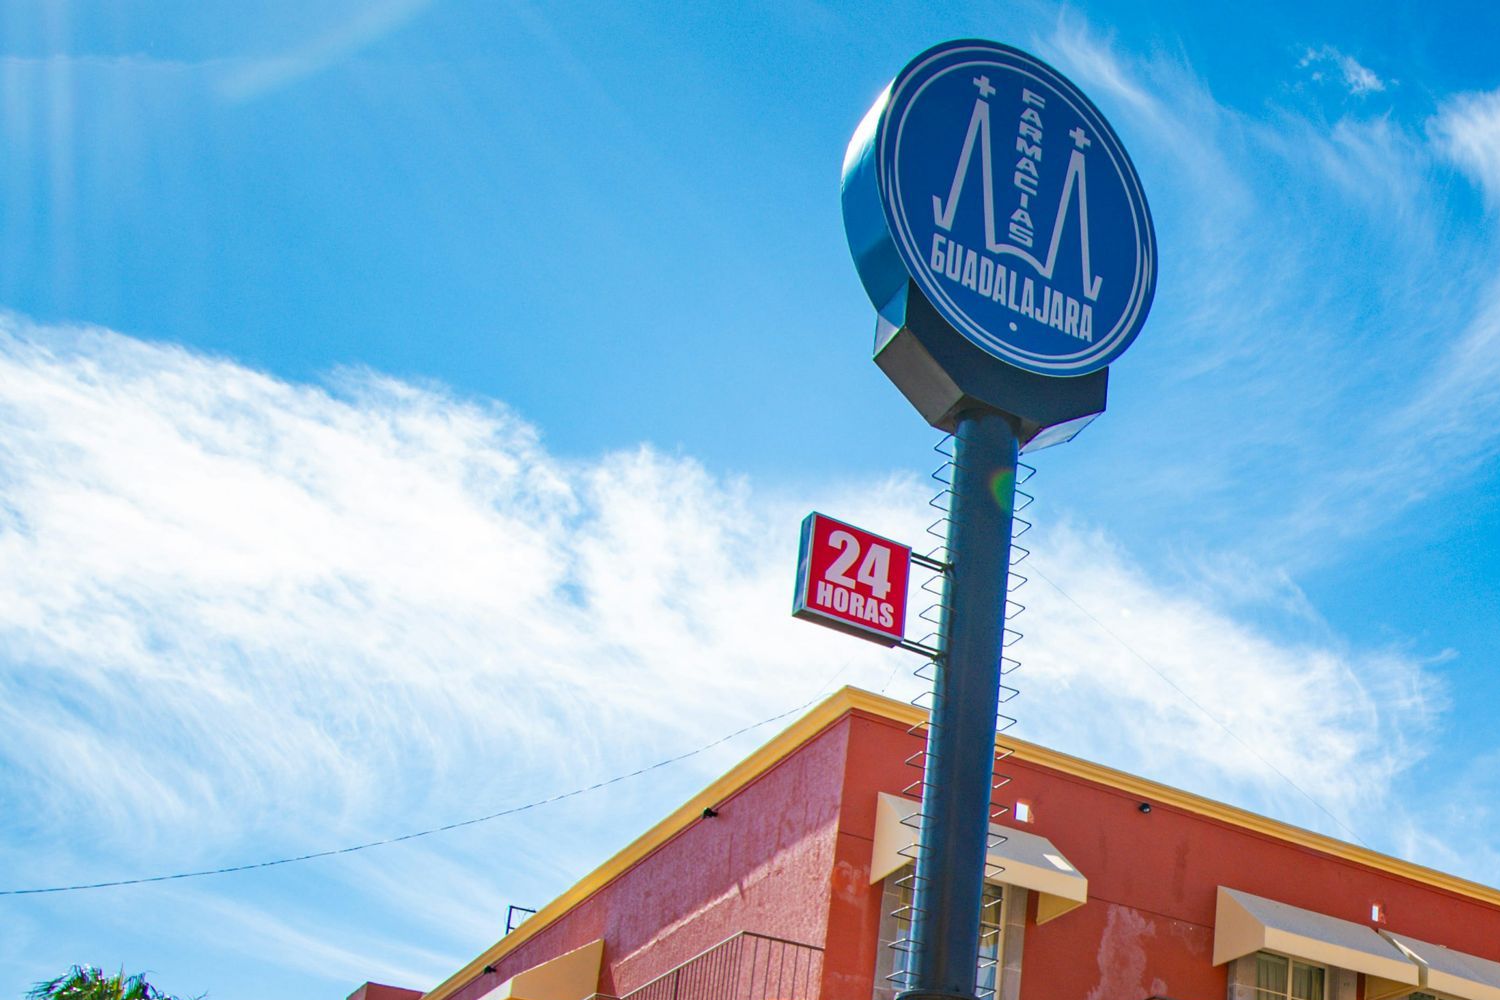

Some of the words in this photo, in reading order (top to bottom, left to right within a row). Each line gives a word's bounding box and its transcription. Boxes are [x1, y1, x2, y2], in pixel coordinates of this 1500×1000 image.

[1008, 88, 1045, 248] FARMACIAS
[930, 233, 1093, 343] GUADALAJARA
[816, 581, 894, 628] HORAS
[824, 530, 891, 600] 24
